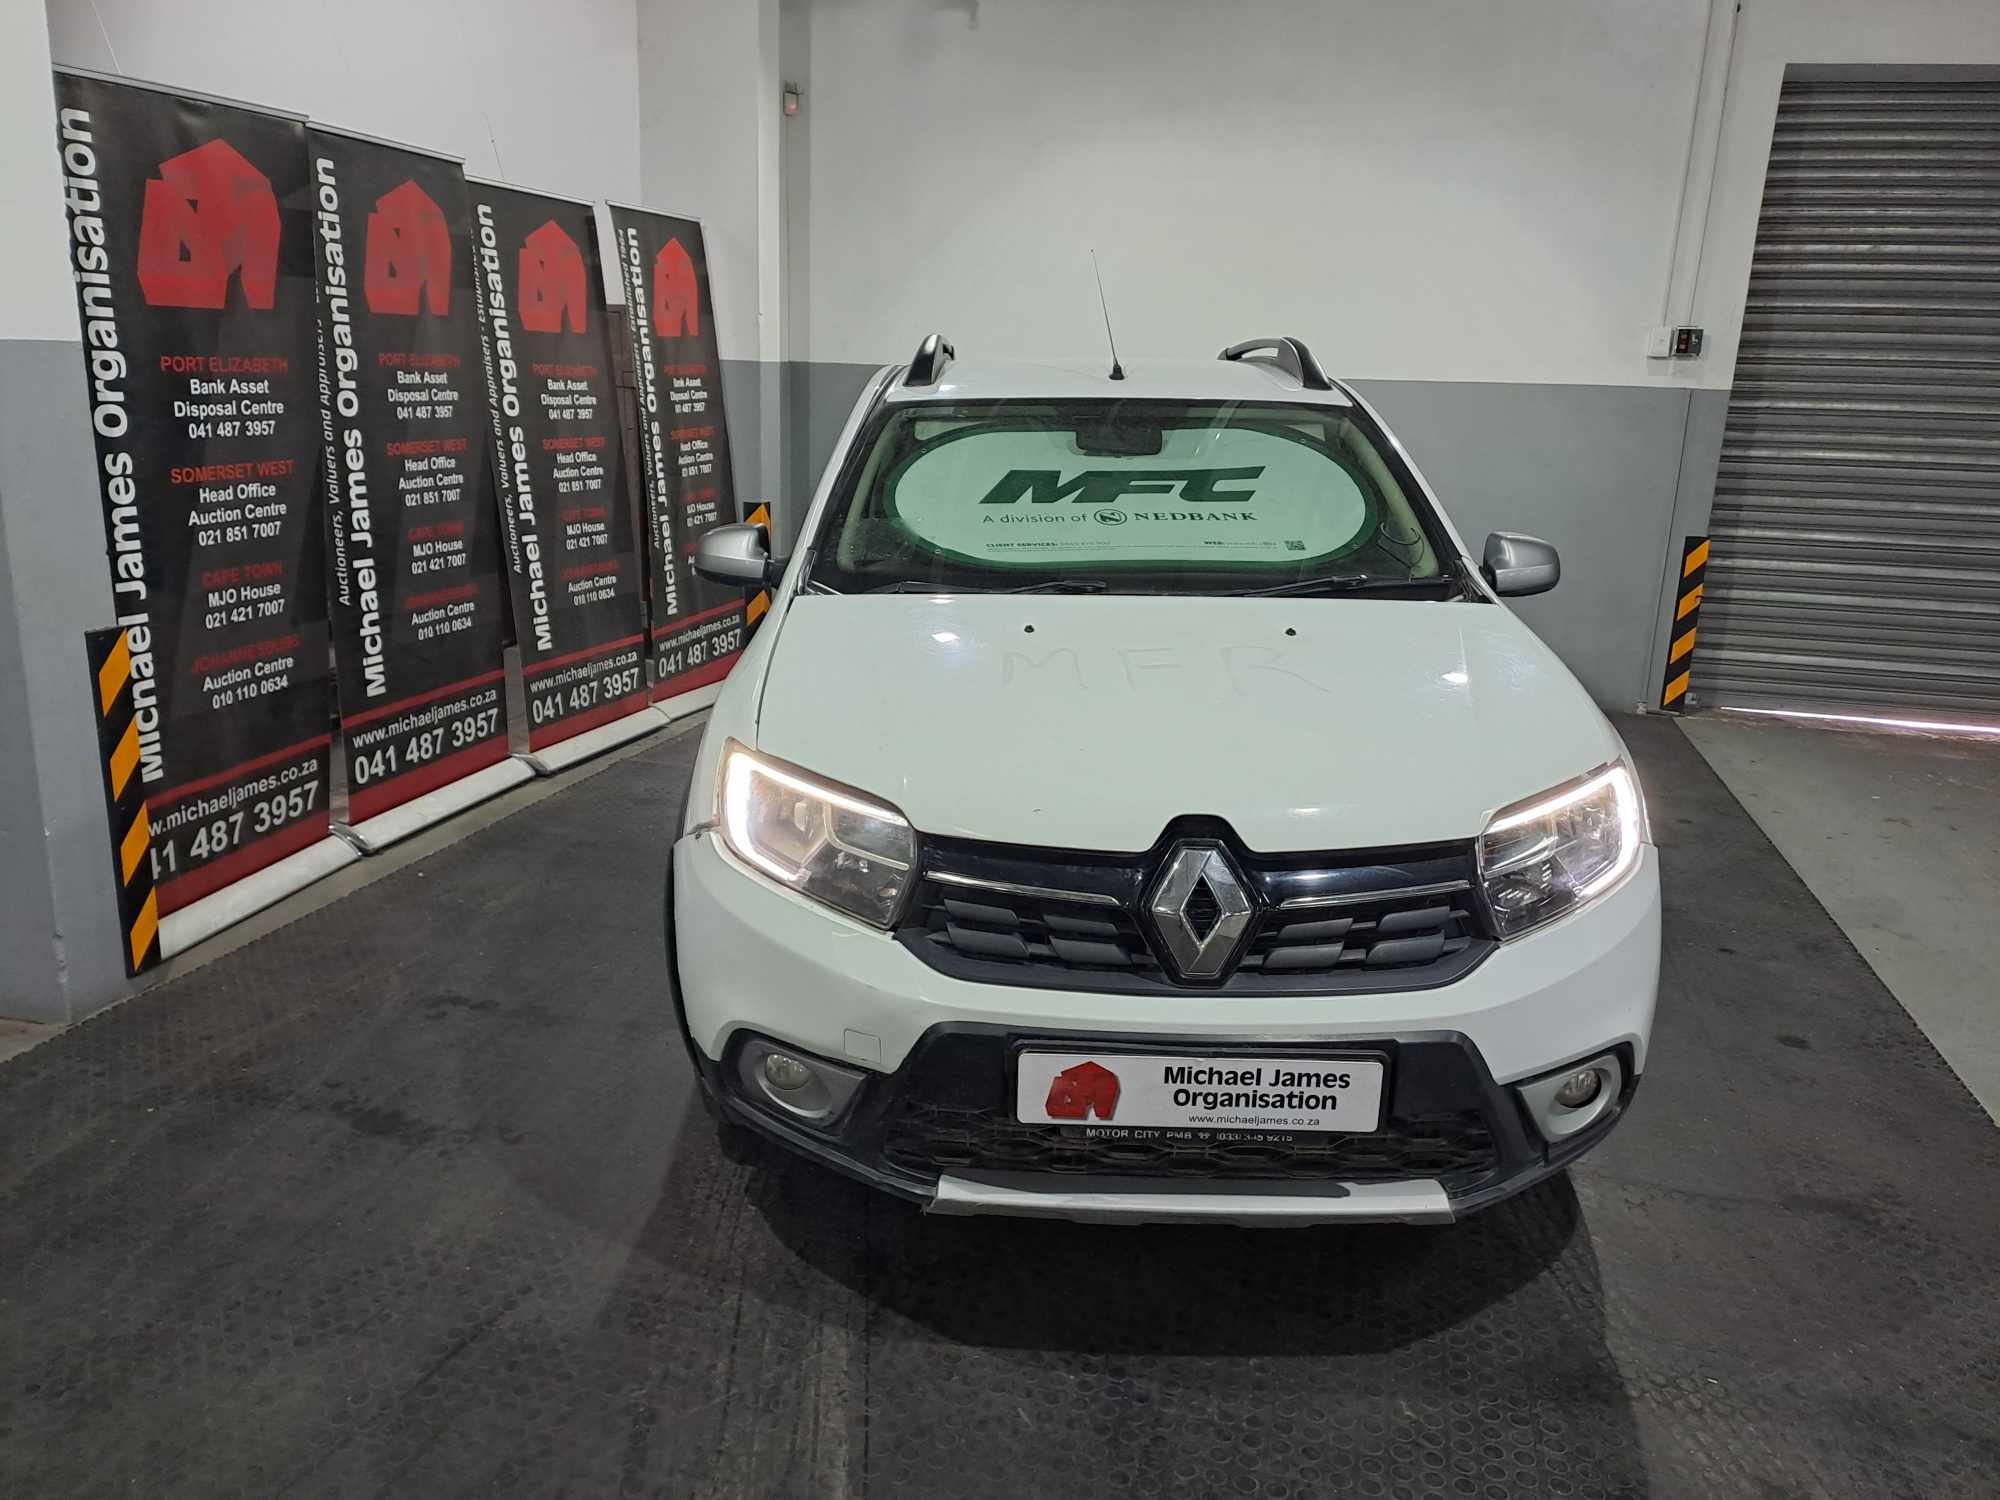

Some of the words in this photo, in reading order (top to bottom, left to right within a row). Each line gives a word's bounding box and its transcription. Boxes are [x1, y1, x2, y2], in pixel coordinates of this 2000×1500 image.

[60, 107, 128, 439] Organisation
[316, 157, 359, 419] Organisation
[477, 203, 520, 418] Organisation
[627, 227, 657, 413] Organisation
[160, 356, 206, 373] PORT
[209, 357, 288, 373] ELIZABETH
[397, 370, 421, 384] Bank
[481, 335, 500, 409] Appraisers
[190, 378, 226, 395] Bank
[229, 378, 270, 394] Asset
[387, 388, 429, 404] Disposal
[431, 388, 459, 401] Centre
[547, 378, 565, 390] Bank
[174, 400, 237, 420] Disposal
[241, 400, 284, 416] Centre
[397, 406, 413, 419] 041
[415, 405, 432, 419] 487
[540, 394, 573, 407] Disposal
[188, 422, 212, 439] 041
[216, 421, 241, 437] 487
[245, 420, 276, 436] 3957
[320, 411, 334, 443] and
[492, 410, 503, 436] and
[170, 463, 253, 484] SOMERSET
[256, 460, 295, 477] WEST
[325, 446, 341, 505] Valuers
[405, 458, 428, 472] Head
[431, 456, 456, 469] Office
[494, 437, 508, 489] Valuers
[509, 426, 536, 525] James
[553, 467, 580, 479] Auction
[650, 421, 668, 507] James
[199, 485, 234, 503] Head
[237, 482, 276, 499] Office
[343, 427, 373, 548] James
[399, 475, 434, 490] Auction
[436, 473, 464, 486] Centre
[979, 466, 1266, 504] MFC
[405, 493, 420, 506] 021
[423, 491, 439, 504] 851
[442, 489, 461, 502] 7007
[105, 451, 146, 601] James
[188, 507, 241, 527] Auction
[245, 502, 287, 519] Centre
[983, 514, 994, 524] A
[1000, 513, 1065, 524] division
[1071, 513, 1088, 524] of
[1134, 511, 1259, 522] NEDBANK
[198, 529, 221, 547] 021
[226, 525, 248, 543] 851
[252, 521, 281, 539] 7007
[504, 494, 522, 574] Auctioneers,
[566, 523, 581, 535] MJO
[582, 522, 605, 534] House
[329, 510, 351, 607] Auctioneers,
[413, 543, 433, 557] MJO
[435, 540, 463, 553] House
[411, 561, 427, 574] 021
[429, 558, 445, 571] 421
[447, 553, 467, 567] 7007
[659, 514, 678, 616] Michael
[208, 588, 237, 608] MJO
[240, 583, 281, 601] House
[522, 534, 553, 651] Michael
[568, 580, 593, 593] Auction
[205, 610, 227, 629] 021
[230, 605, 253, 623] 421
[257, 598, 285, 617] 7007
[411, 608, 446, 625] Auction
[447, 602, 475, 617] Centre
[352, 556, 387, 698] Michael
[418, 626, 434, 641] 010
[436, 621, 450, 635] 110
[452, 616, 472, 632] 0634
[659, 614, 740, 651] www.michaeljames.co.za
[658, 652, 682, 678] 041
[687, 642, 708, 667] 487
[712, 629, 742, 656] 3957
[202, 668, 251, 692] Auction
[254, 656, 294, 677] Centre
[530, 650, 638, 694] www.michaeljames.co.za
[212, 690, 234, 709] 010
[236, 683, 257, 701] 110
[260, 674, 288, 694] 0634
[532, 691, 563, 724] 041
[569, 679, 598, 708] 487
[604, 667, 640, 699] 3957
[353, 688, 497, 749] www.michaeljames.co.za
[355, 746, 397, 785] 041
[405, 727, 444, 765] 487
[451, 707, 498, 748] 3957
[190, 811, 246, 862] 487
[253, 780, 320, 836] 3957
[1163, 1065, 1262, 1087] Michael
[1268, 1068, 1351, 1089] James
[1172, 1087, 1337, 1111] Organisation
[1188, 1113, 1320, 1128] www.michaeljames.co.za
[1086, 1129, 1129, 1140] MOTOR
[1134, 1130, 1160, 1140] CITY
